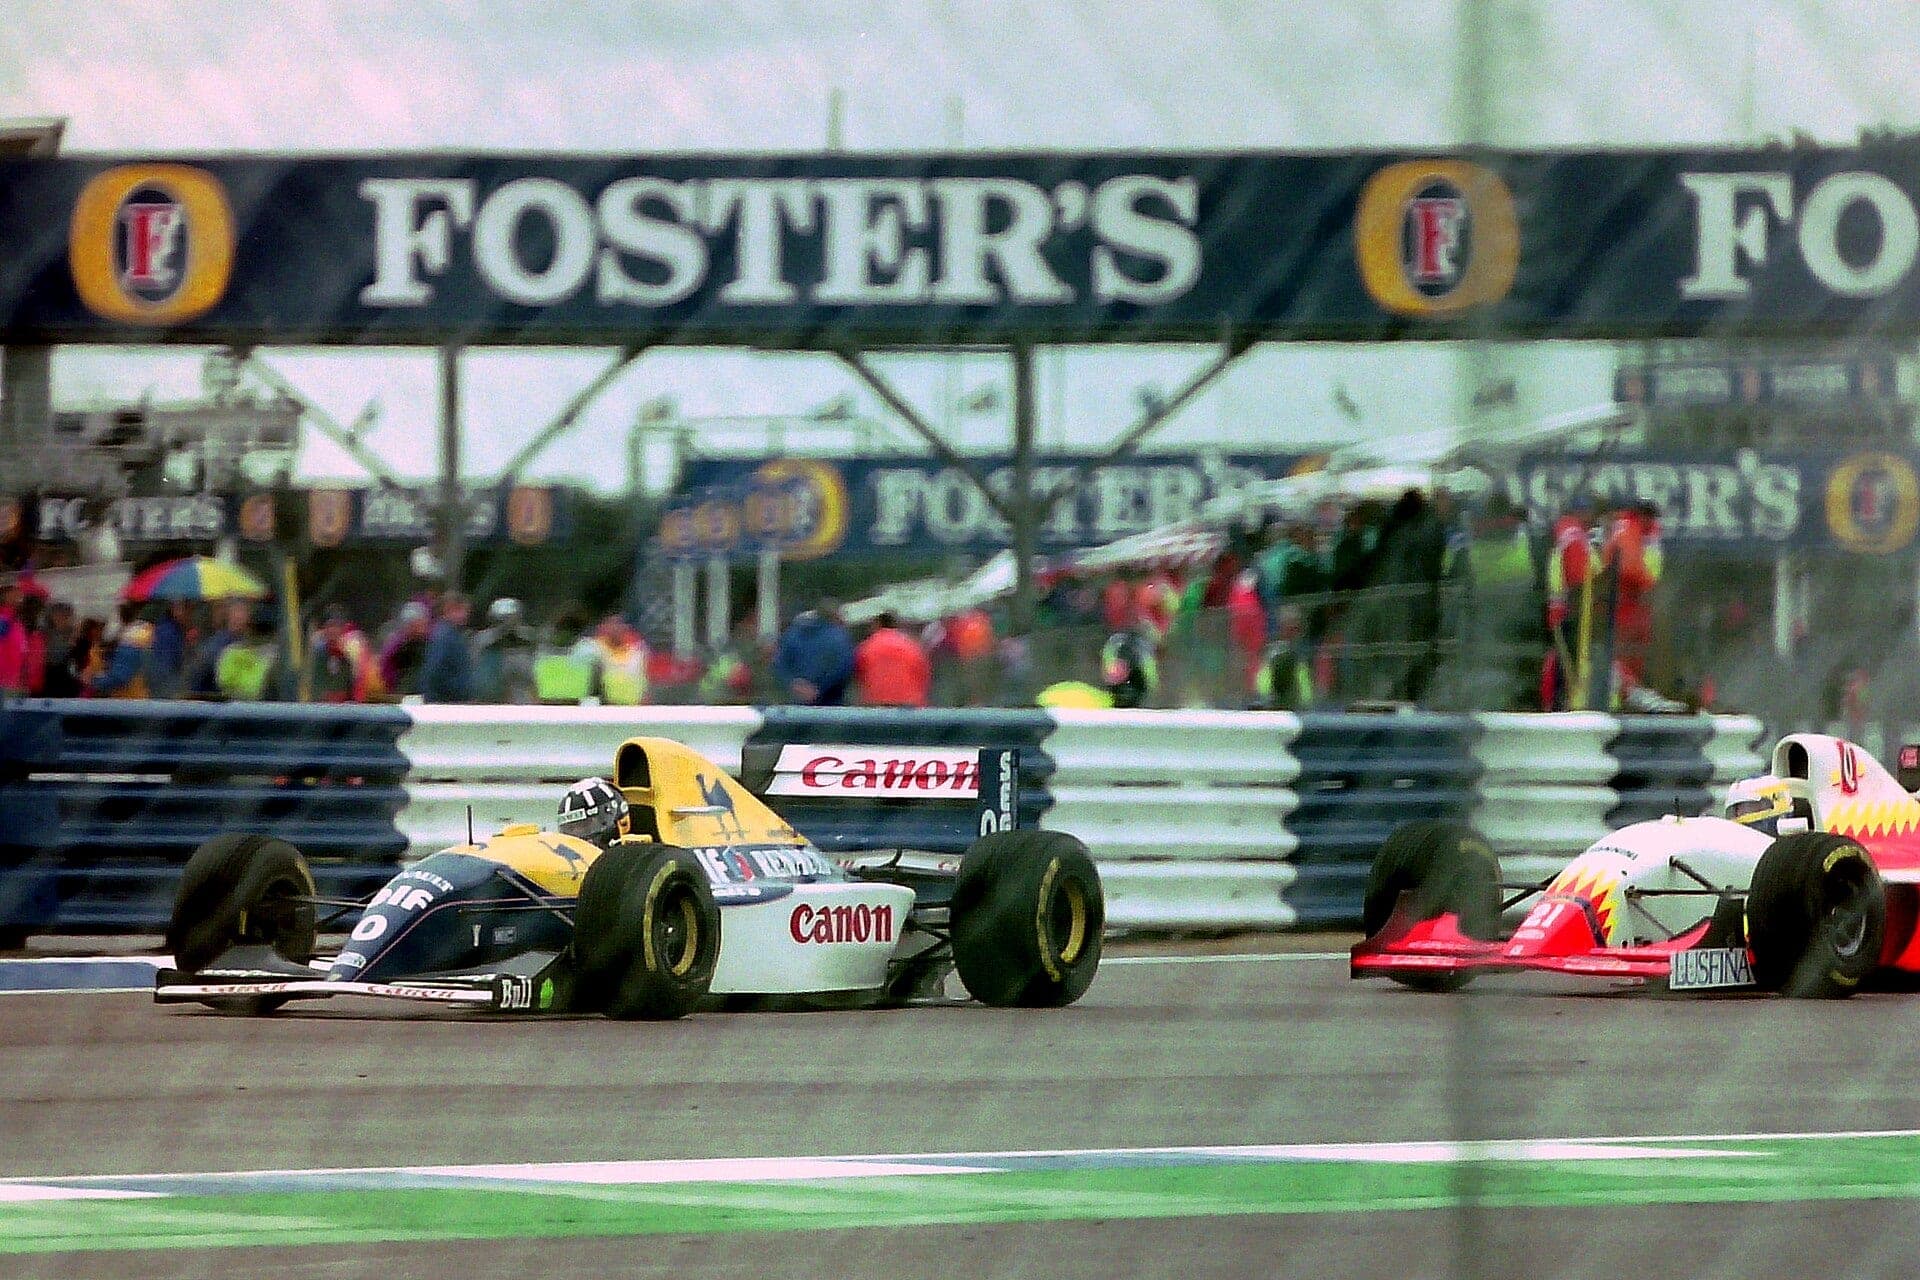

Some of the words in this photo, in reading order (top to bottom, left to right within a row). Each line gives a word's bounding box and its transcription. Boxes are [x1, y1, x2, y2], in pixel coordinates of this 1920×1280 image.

[361, 175, 1202, 306] FOSTER'S
[802, 756, 980, 790] Canon
[789, 903, 892, 944] Canon
[1521, 903, 1565, 929] 21
[1675, 949, 1751, 986] LUSFINA
